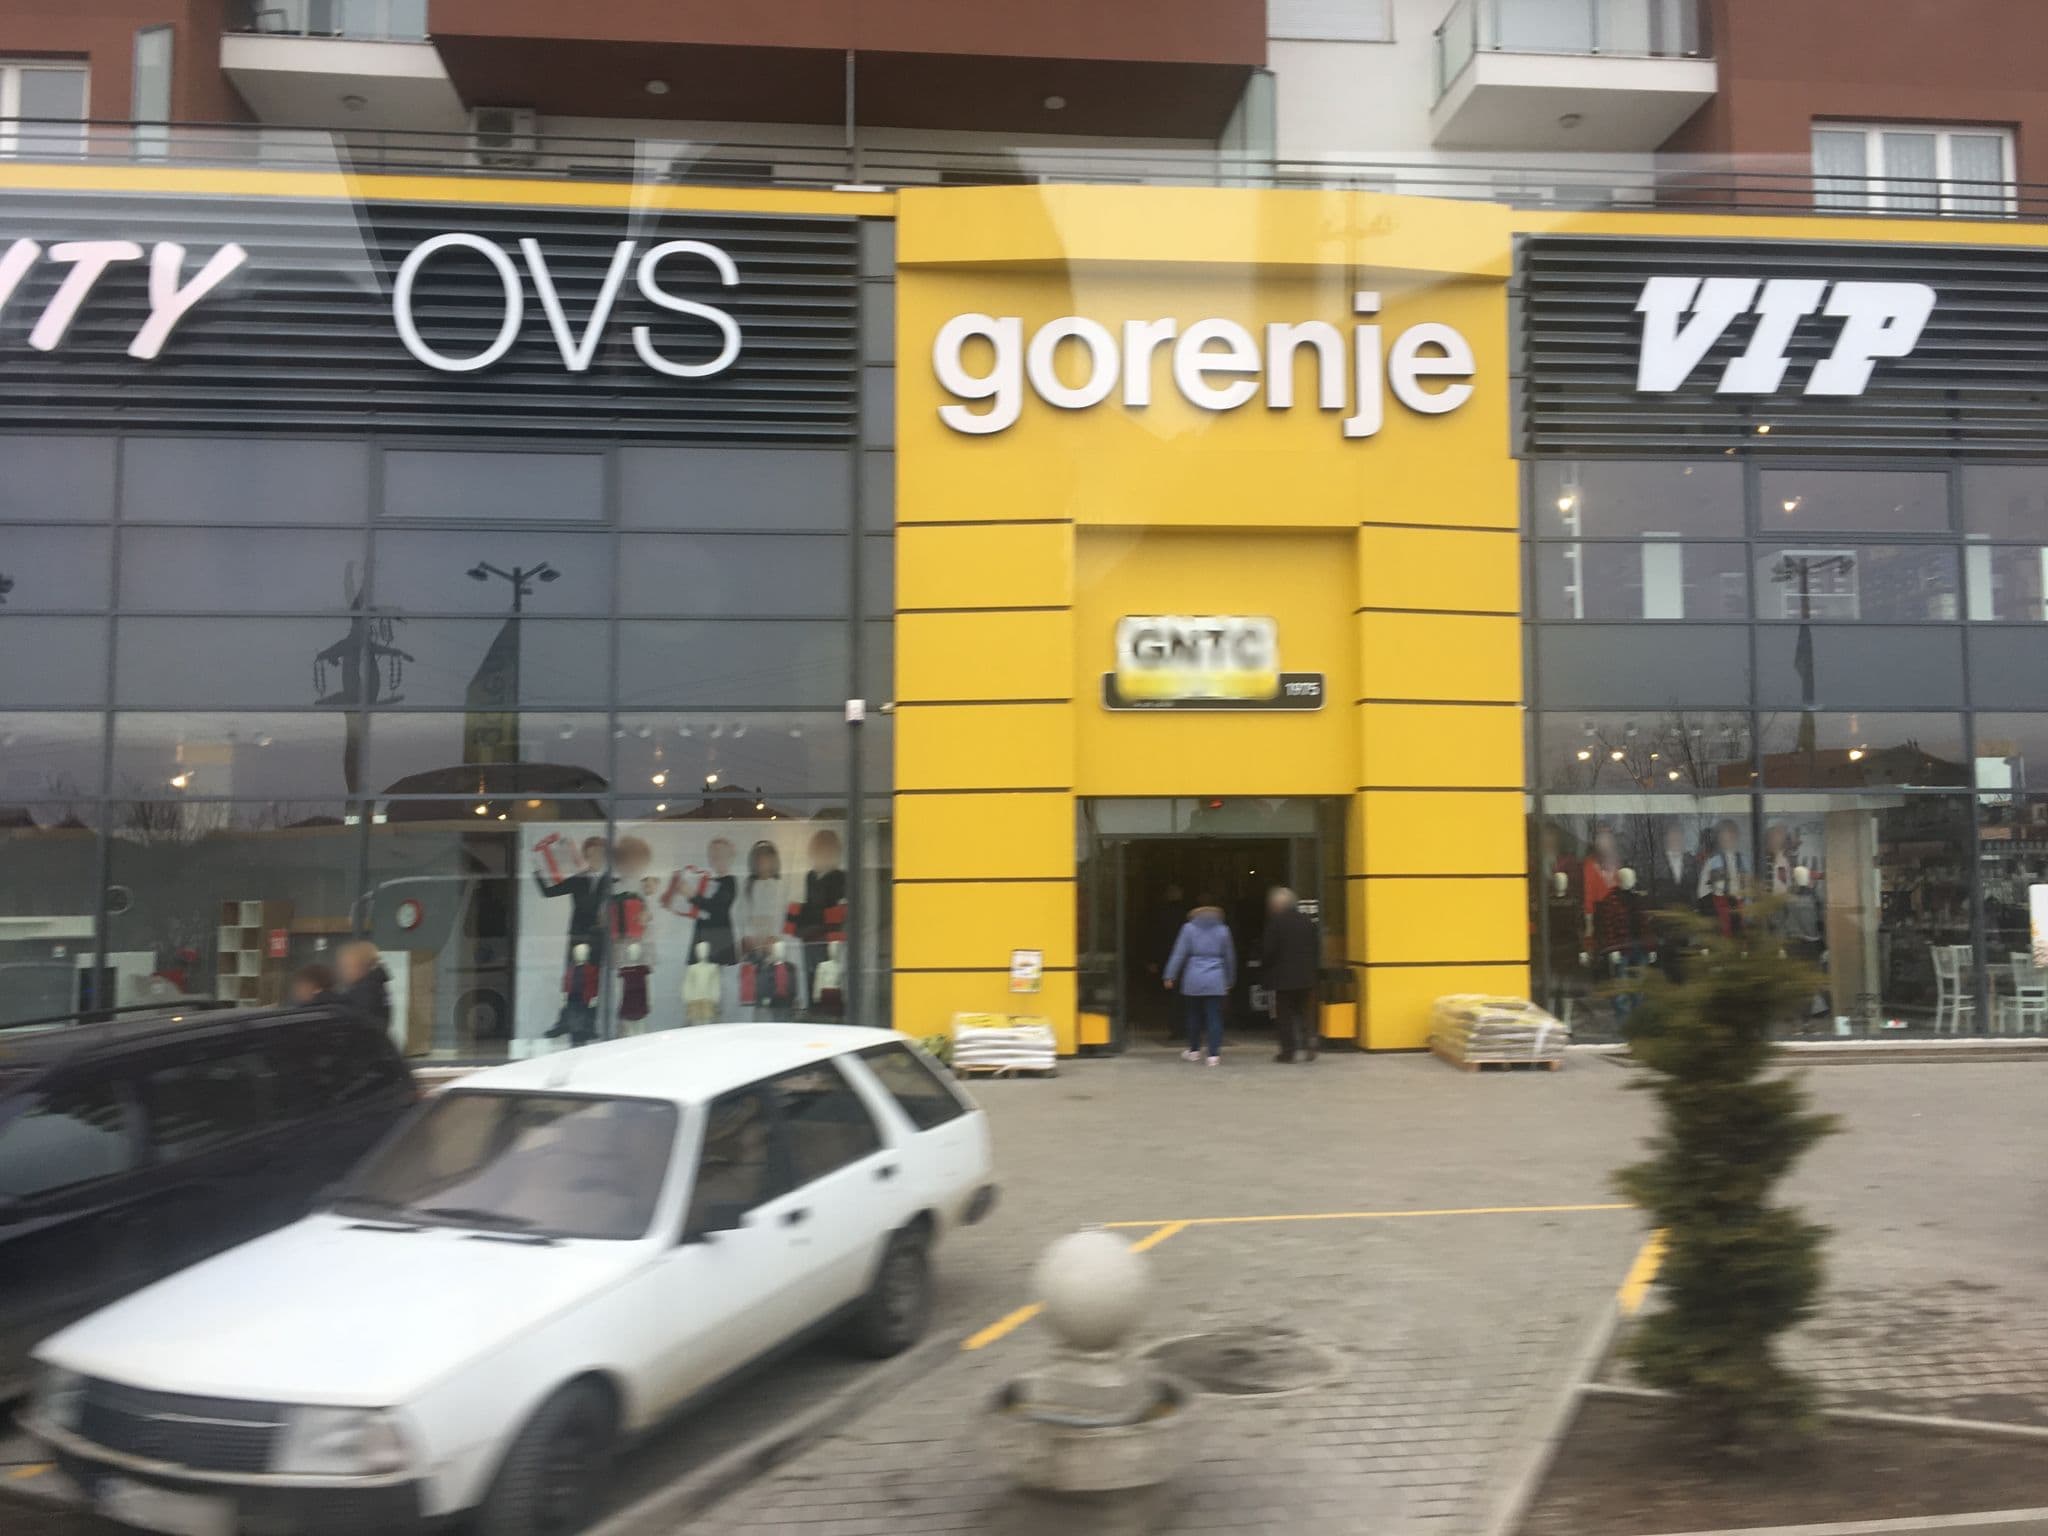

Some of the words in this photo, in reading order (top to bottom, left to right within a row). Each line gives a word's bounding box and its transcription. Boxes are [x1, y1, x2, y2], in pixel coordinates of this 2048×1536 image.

[391, 232, 743, 377] OVS
[932, 291, 1476, 437] gorenje
[1633, 276, 1937, 395] VIP
[1132, 628, 1265, 670] GNTC
